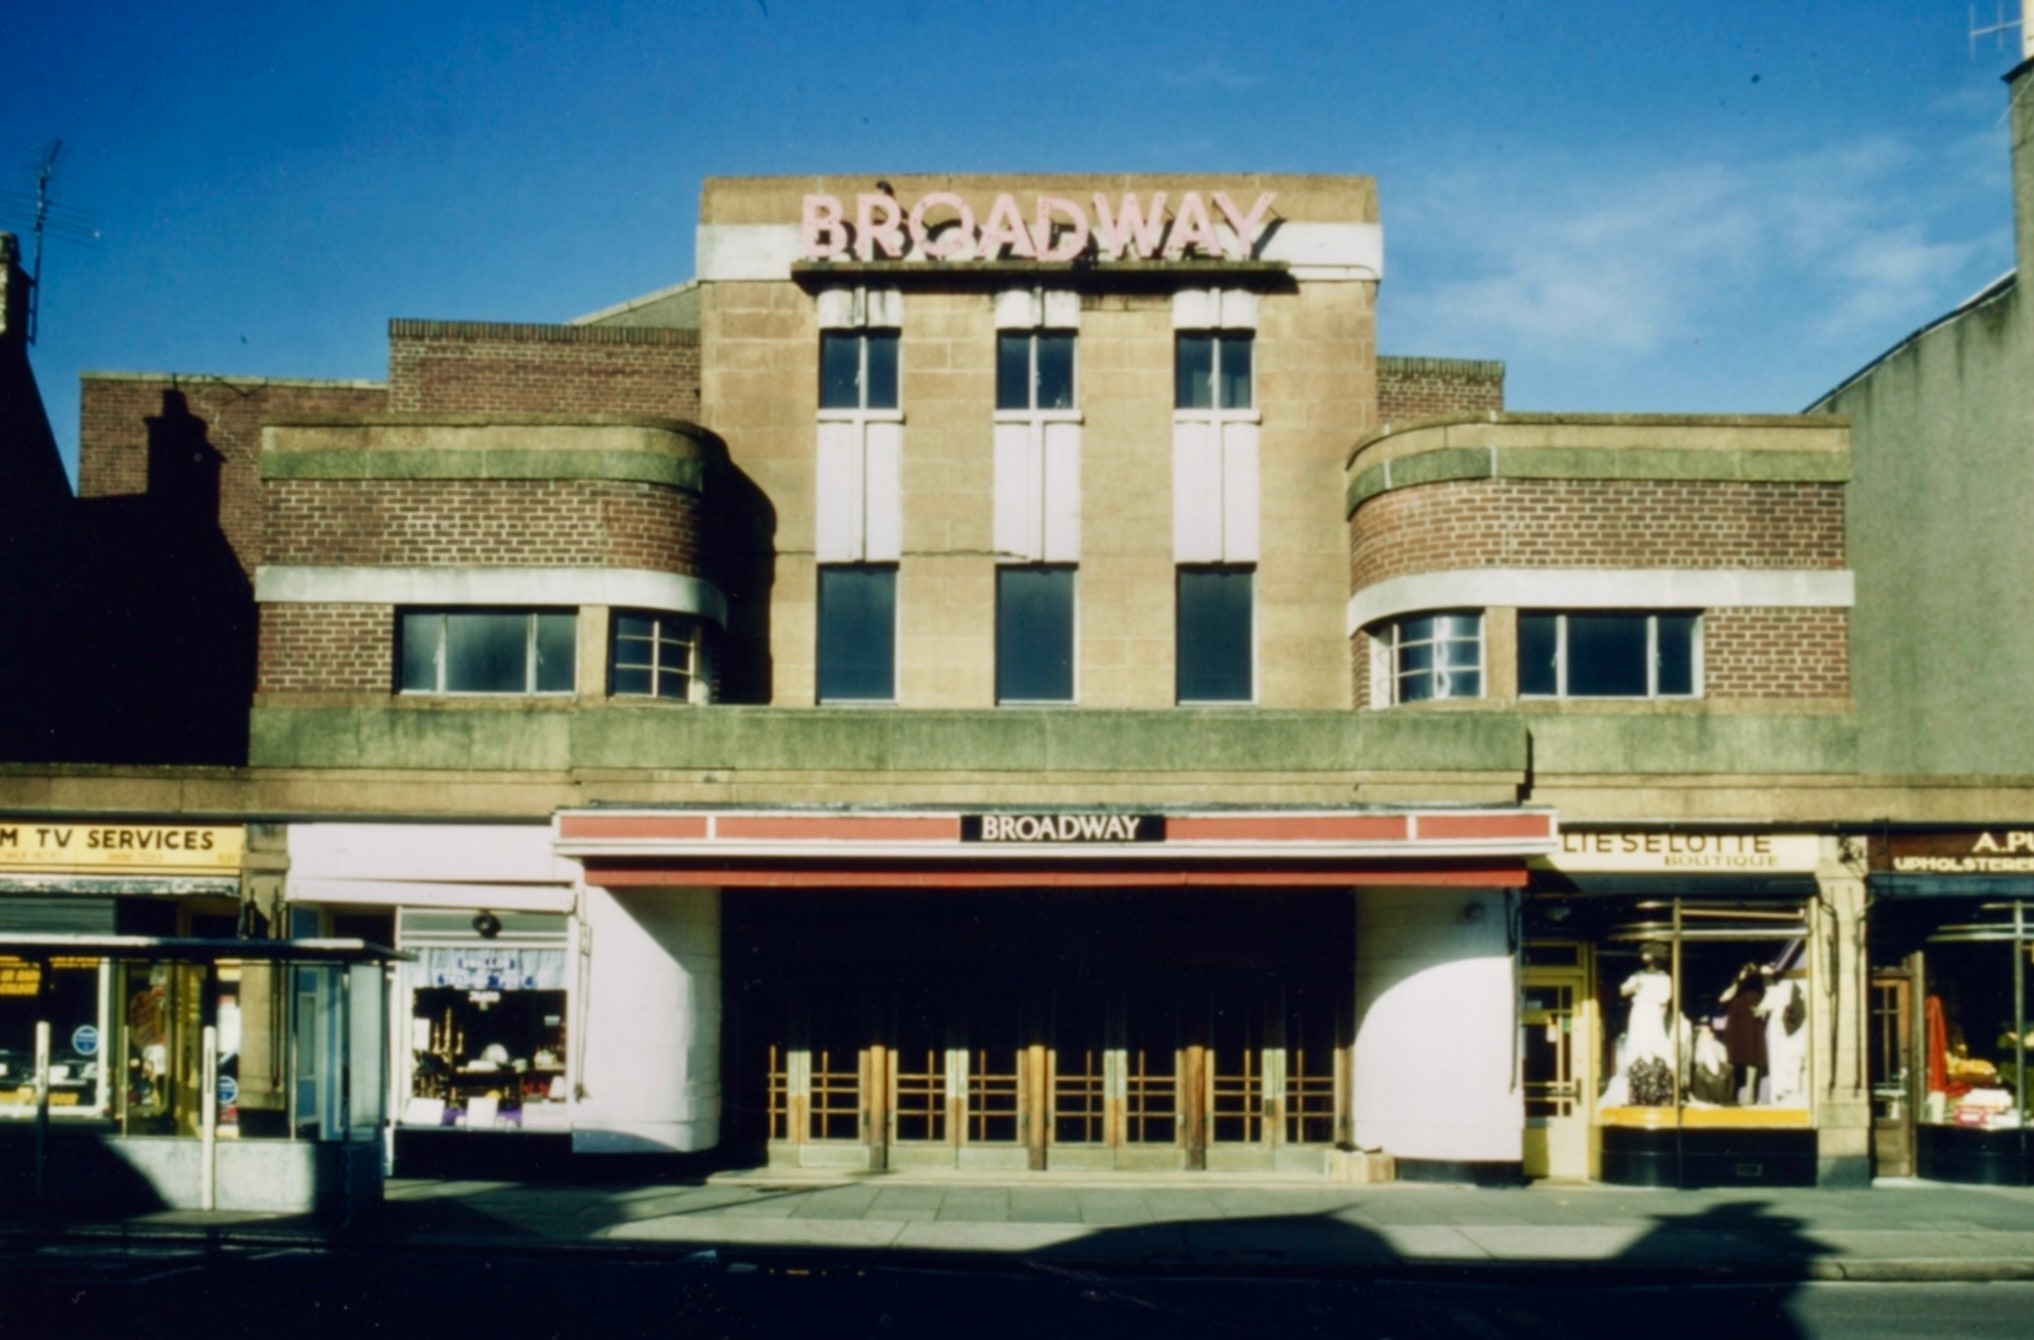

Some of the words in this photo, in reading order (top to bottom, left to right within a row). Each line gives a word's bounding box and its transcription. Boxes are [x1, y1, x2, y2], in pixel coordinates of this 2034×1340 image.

[802, 191, 1277, 262] BROADWAY
[981, 815, 1140, 840] BROADWAY
[36, 829, 73, 848] TV
[87, 829, 214, 850] SERVICES
[1562, 832, 1772, 853] LIESELOTTE
[1664, 855, 1779, 868] BOUTIQUE
